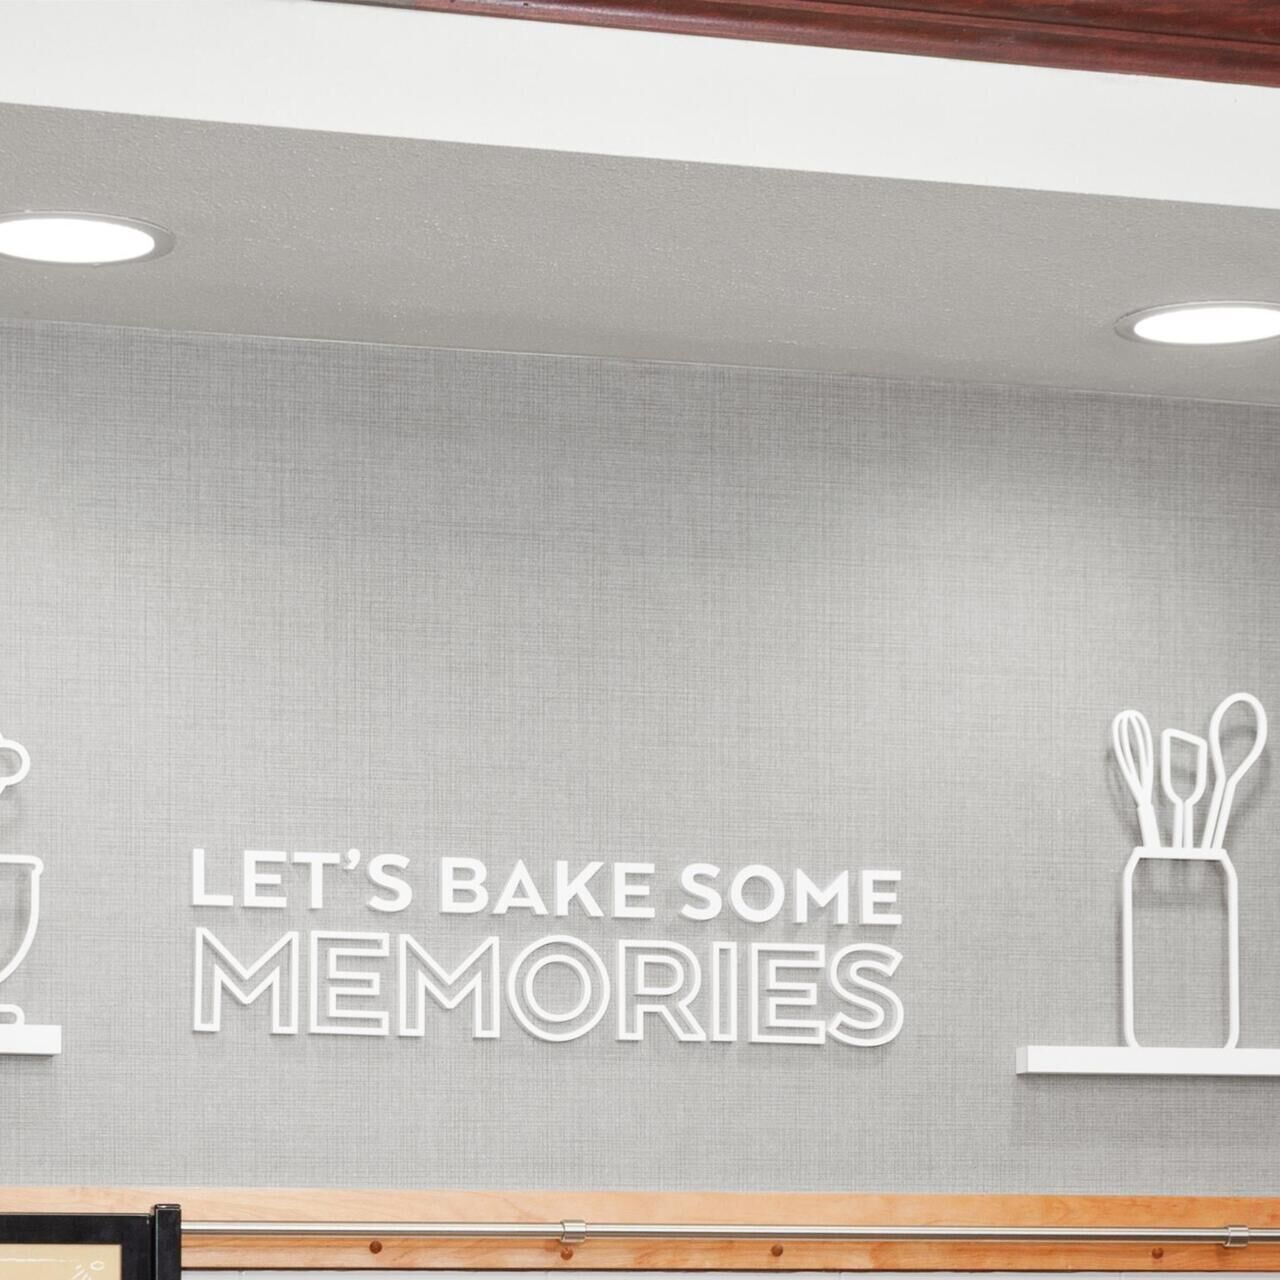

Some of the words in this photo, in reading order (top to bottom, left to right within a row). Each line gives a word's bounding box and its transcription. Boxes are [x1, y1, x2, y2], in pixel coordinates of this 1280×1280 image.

[192, 847, 413, 912] LET'S
[441, 856, 656, 918] BAKE
[680, 862, 903, 925] SOME
[192, 926, 905, 1047] MEMORIES
